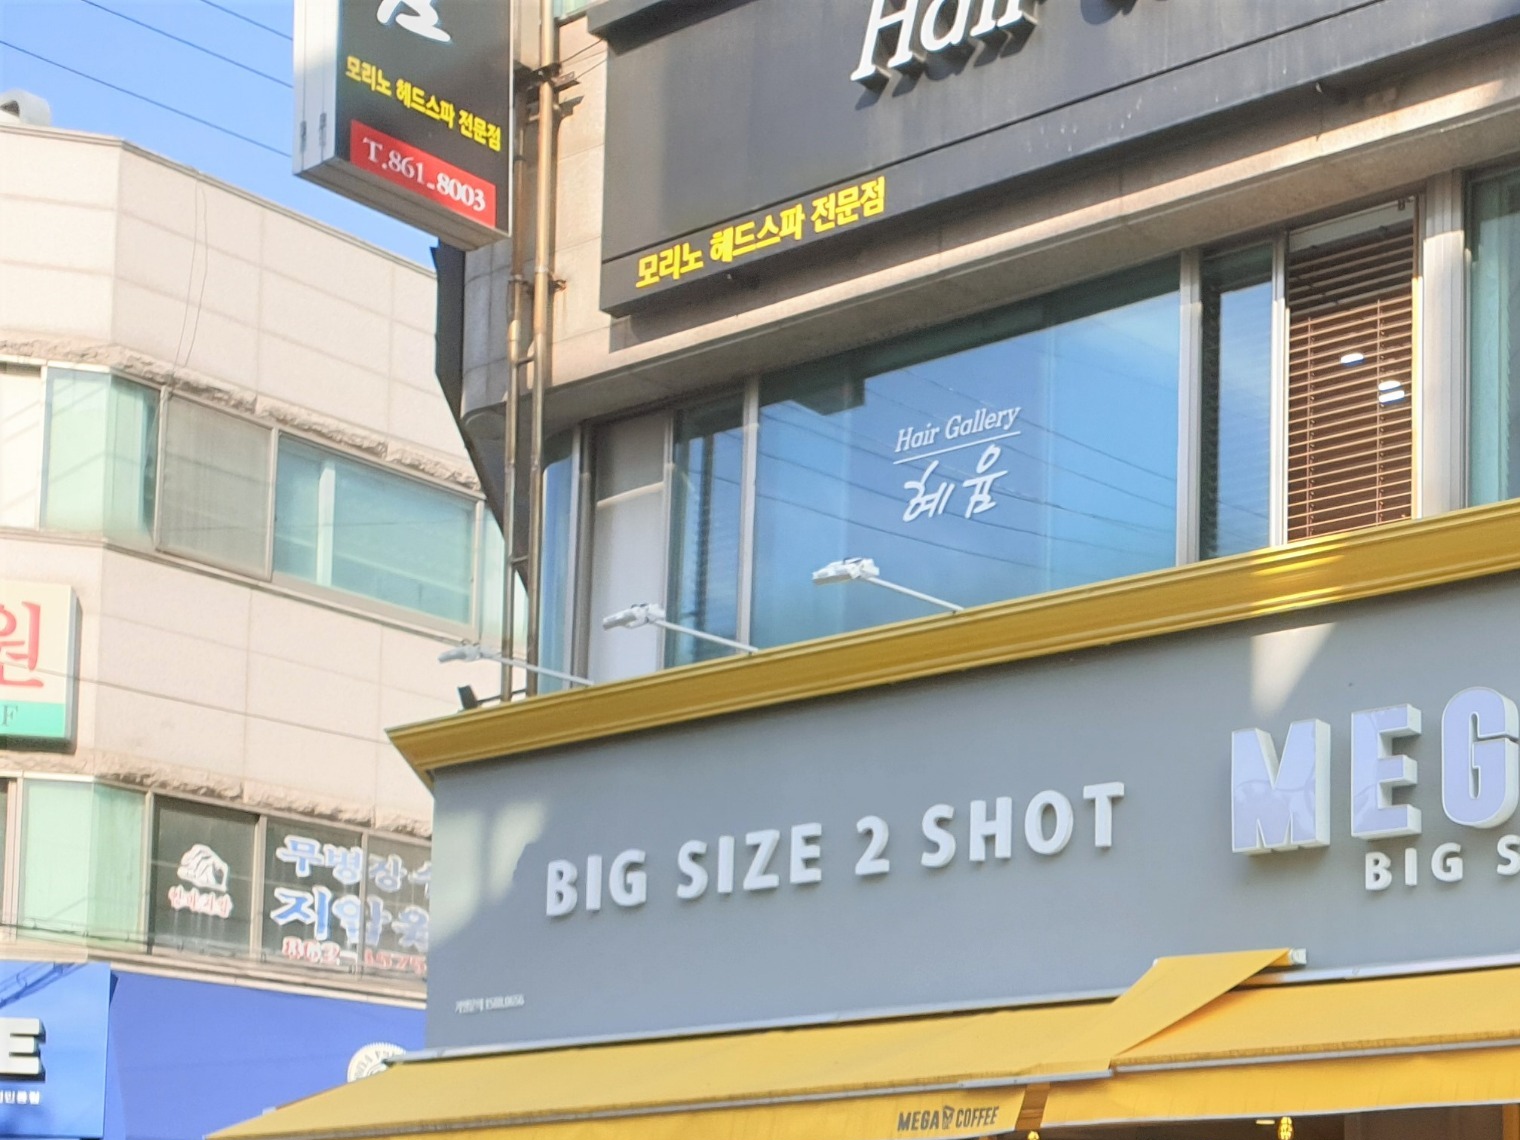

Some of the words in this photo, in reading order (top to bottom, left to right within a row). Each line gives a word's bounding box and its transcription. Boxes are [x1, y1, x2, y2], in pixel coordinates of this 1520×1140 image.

[346, 55, 392, 96] 모리노
[395, 78, 455, 129] 헤드스파
[458, 108, 501, 152] 전문점
[635, 247, 704, 289] 모리노
[709, 203, 806, 263] 헤드스파
[811, 176, 886, 232] 전문점
[895, 422, 940, 452] Hair
[945, 406, 1021, 440] Gallery
[546, 849, 647, 916] BIG
[677, 823, 822, 899] SIZE
[855, 815, 890, 876] 2
[921, 782, 1124, 868] SHOT
[1365, 842, 1463, 891] BIG
[897, 1111, 938, 1132] MEGA
[955, 1106, 999, 1128] COFFEE
